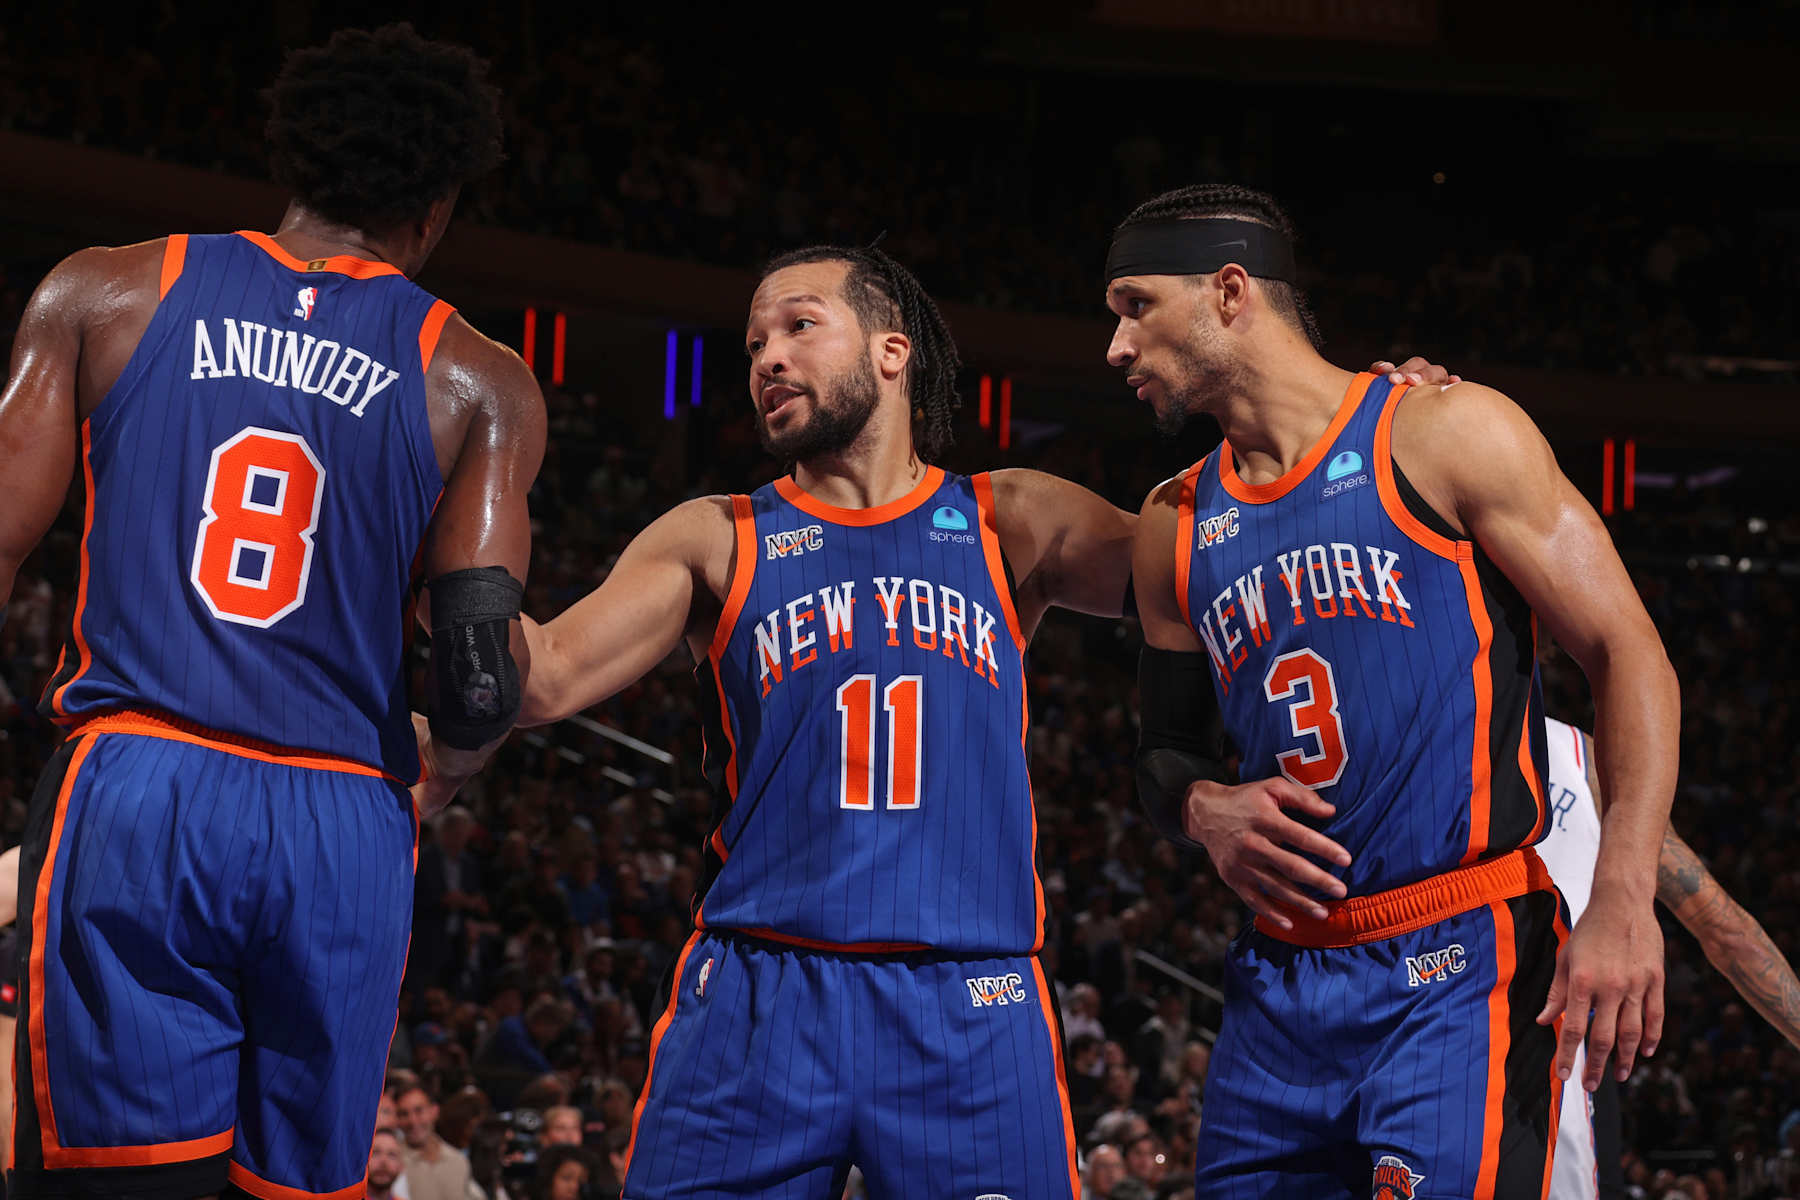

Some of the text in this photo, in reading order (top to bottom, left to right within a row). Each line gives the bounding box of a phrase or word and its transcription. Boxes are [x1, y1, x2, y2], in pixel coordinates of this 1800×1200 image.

[190, 318, 400, 418] ANUNOBY
[1323, 473, 1368, 498] sphere
[190, 426, 326, 629] 8
[765, 525, 824, 560] NYC
[929, 530, 975, 545] sphere
[1198, 507, 1240, 550] NYC
[754, 577, 999, 692] NEW YORK
[1199, 542, 1414, 690] NEW YORK
[836, 674, 923, 811] 11
[1263, 647, 1349, 791] 3
[966, 973, 1026, 1007] NYC
[1405, 944, 1466, 987] NYC
